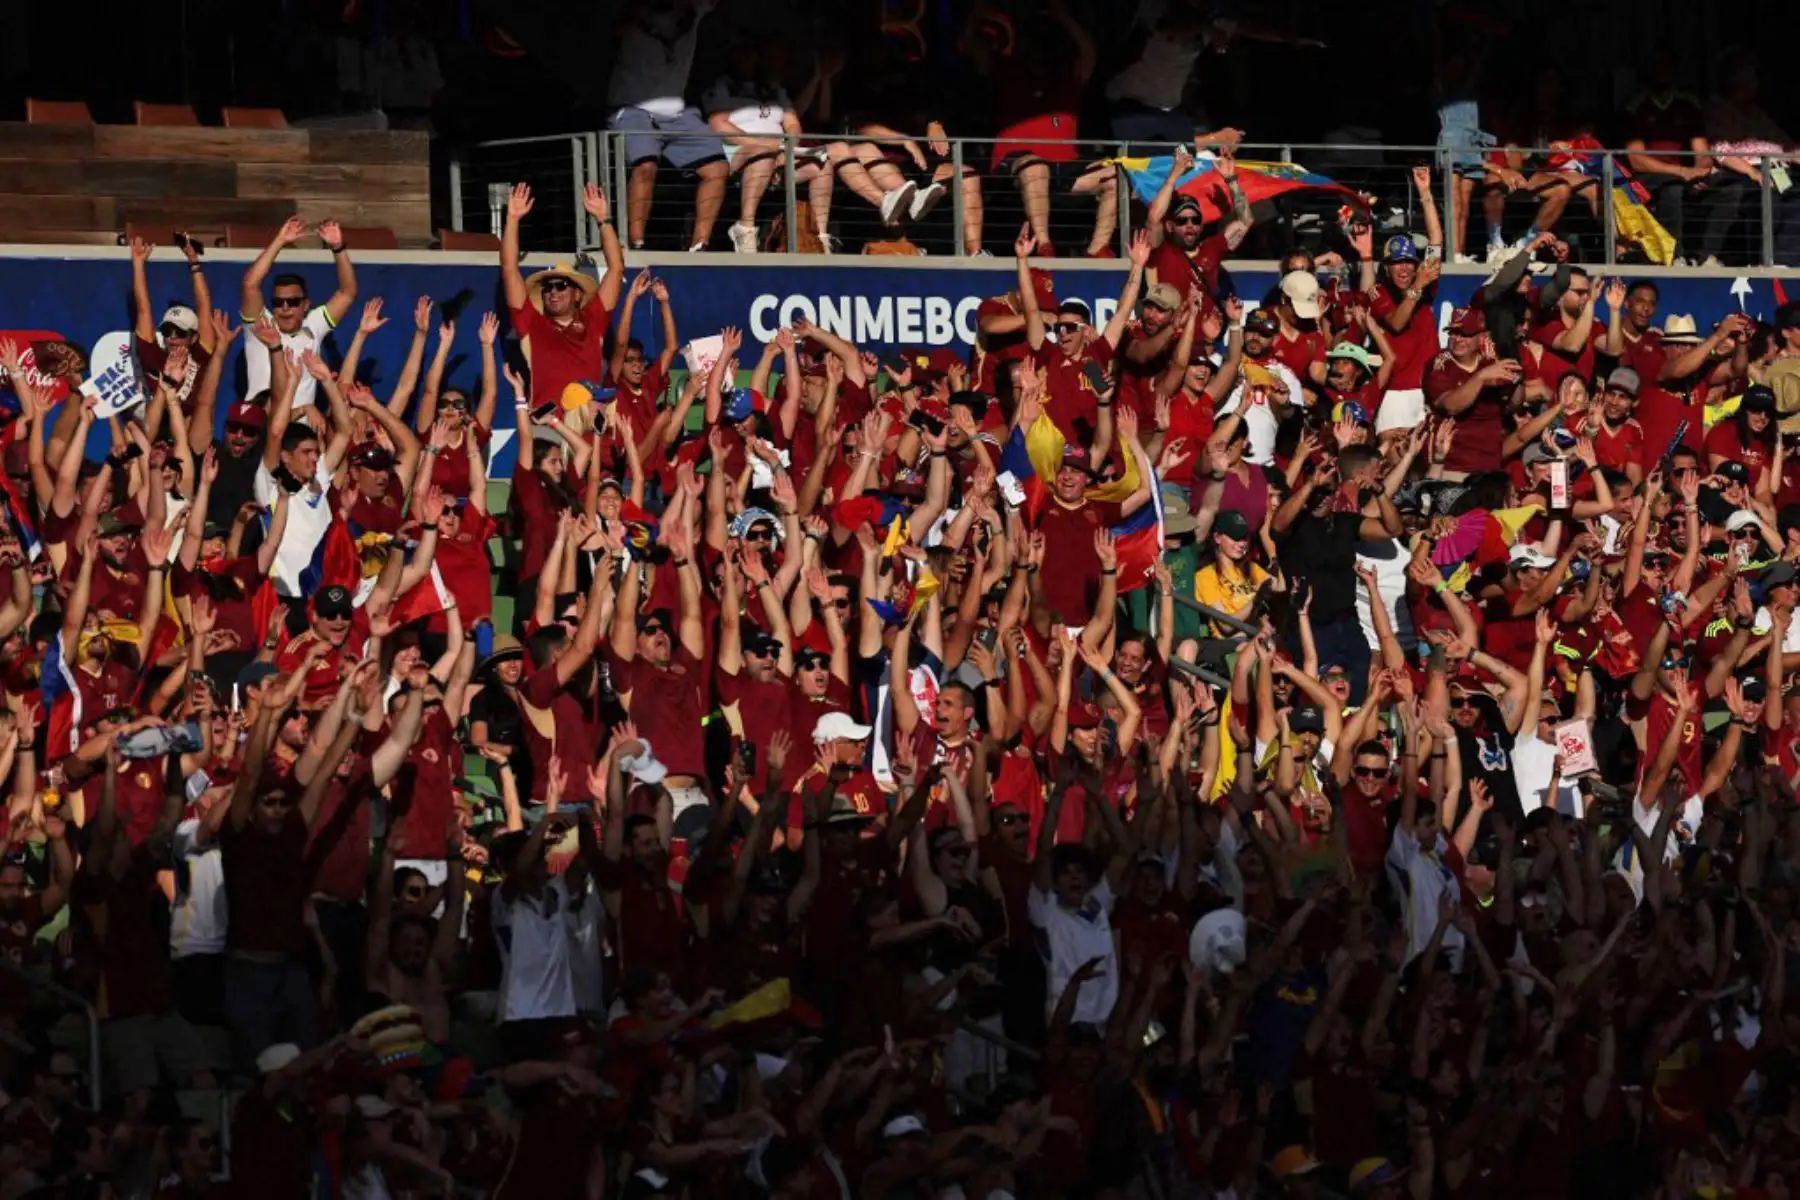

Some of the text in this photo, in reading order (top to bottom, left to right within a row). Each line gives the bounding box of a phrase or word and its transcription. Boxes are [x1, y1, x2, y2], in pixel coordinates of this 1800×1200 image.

[750, 294, 984, 346] CONMEBO
[1683, 721, 1695, 744] 9
[853, 791, 870, 813] 10
